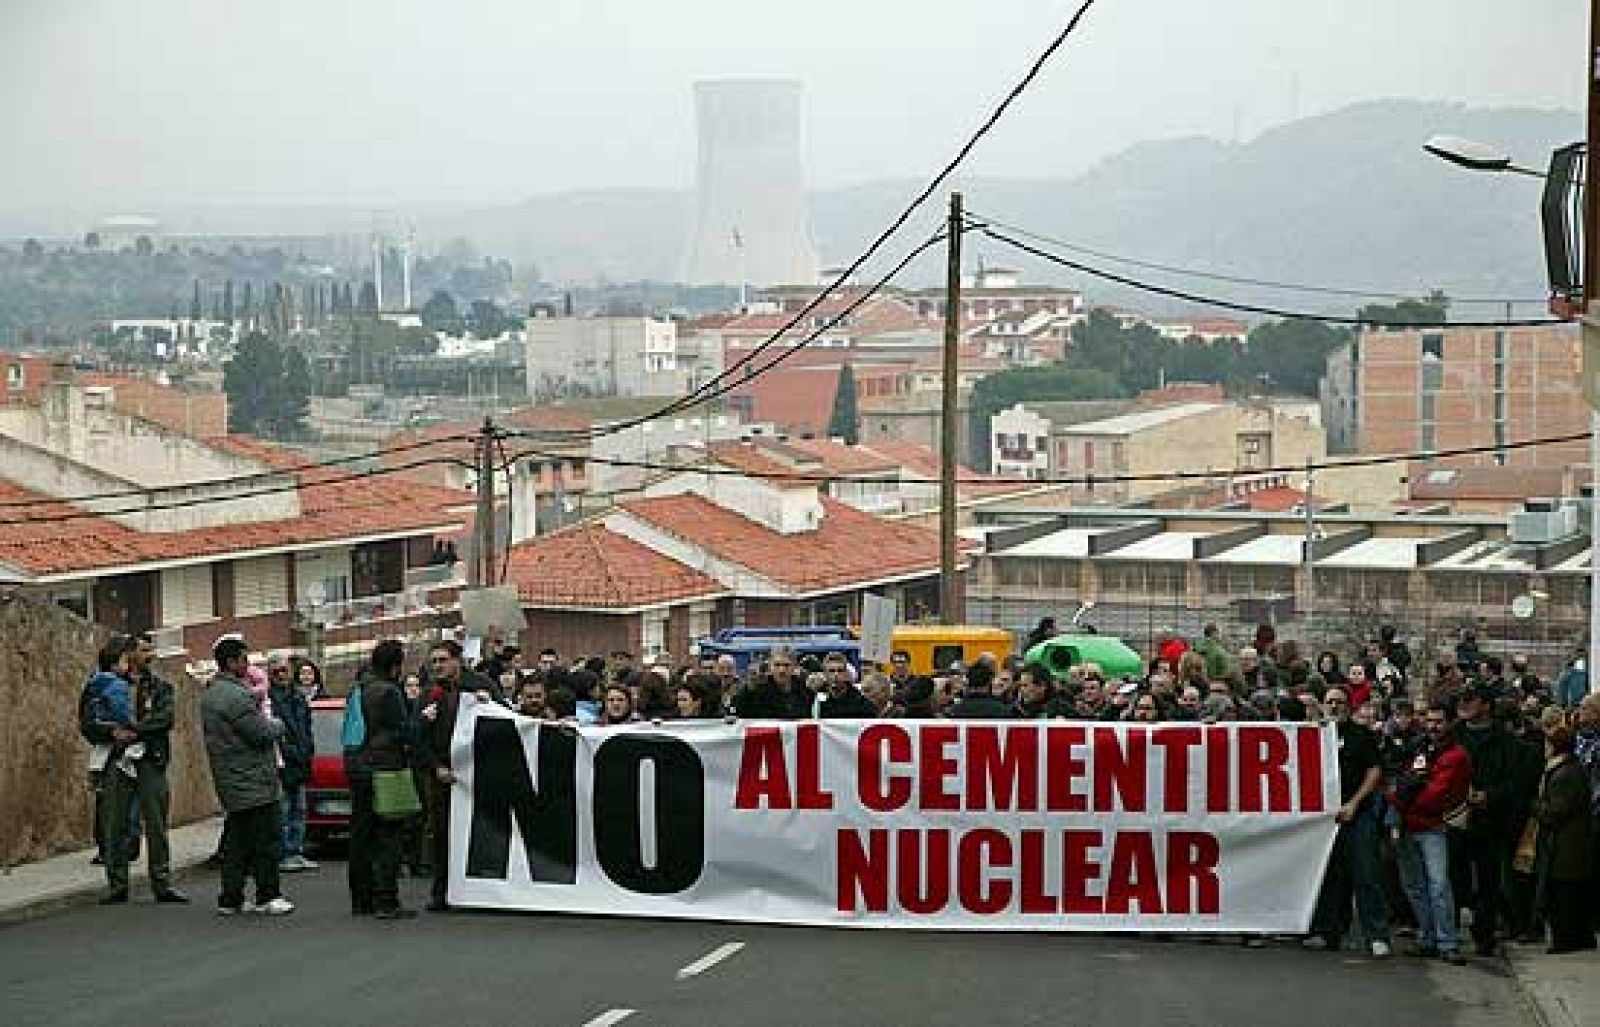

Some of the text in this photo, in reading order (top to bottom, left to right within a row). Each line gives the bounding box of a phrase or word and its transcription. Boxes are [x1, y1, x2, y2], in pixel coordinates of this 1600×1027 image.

[465, 716, 705, 894] NO
[735, 723, 1324, 813] AL CEMENTIRI
[836, 828, 1221, 915] NUCLEAR
